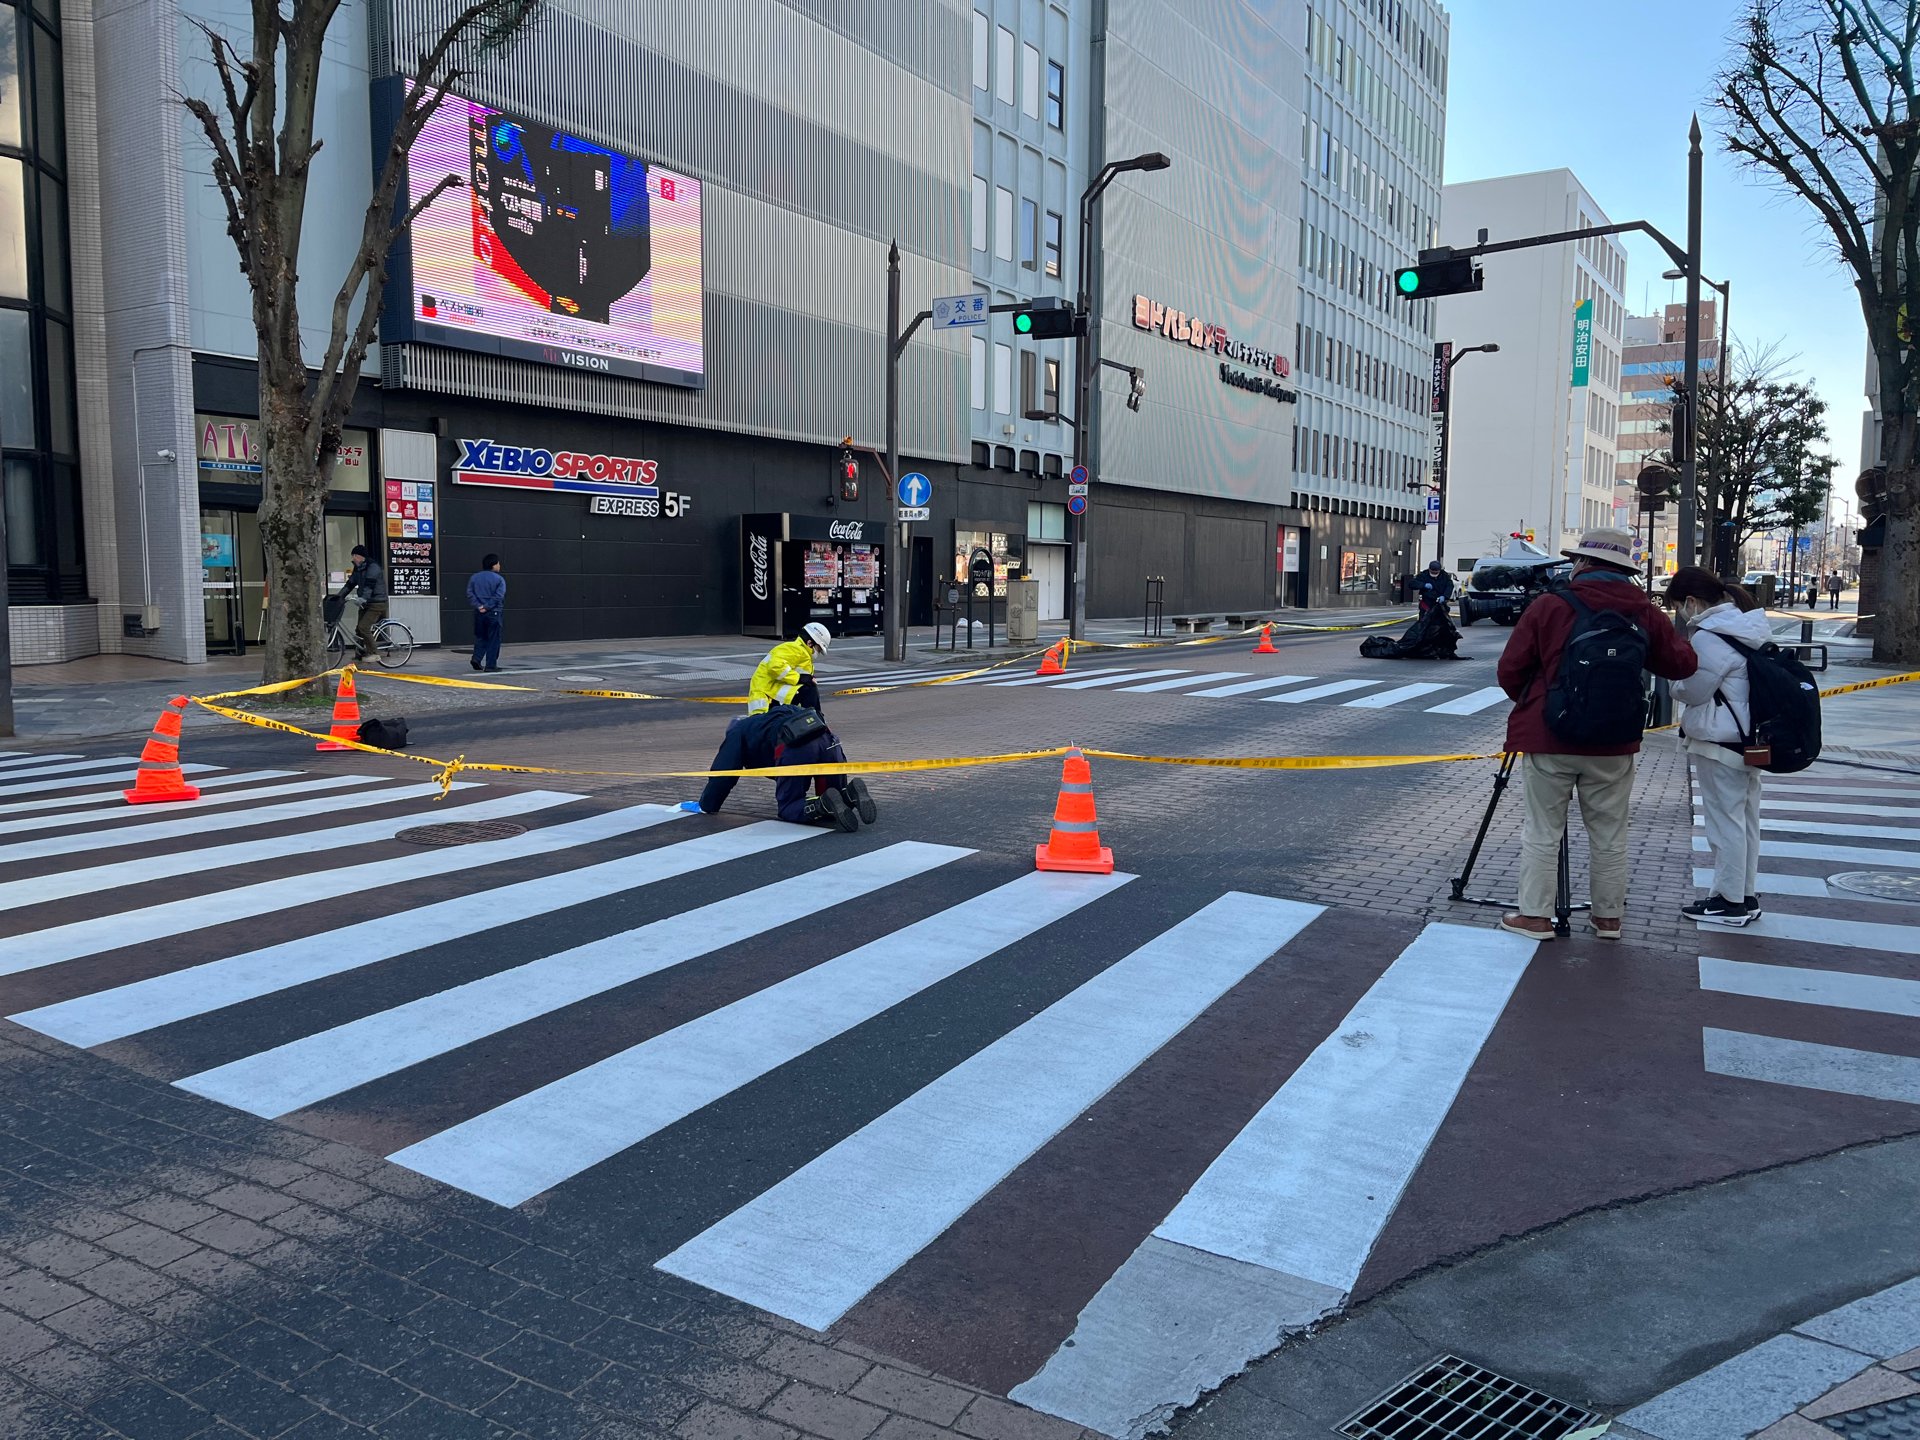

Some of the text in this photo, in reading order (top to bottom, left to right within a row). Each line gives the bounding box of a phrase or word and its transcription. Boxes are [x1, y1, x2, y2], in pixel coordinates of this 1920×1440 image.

[955, 298, 984, 313] 交番
[958, 313, 982, 321] POLICE
[1133, 294, 1227, 354] ヨドバシカメラ
[1575, 320, 1590, 367] 明治安田
[561, 351, 609, 371] VISION
[459, 439, 658, 485] XEBIO SPORTS
[596, 492, 692, 518] EXPRESS 5F
[830, 520, 864, 540] Coca-Cola
[750, 532, 768, 600] Coca-Cola
